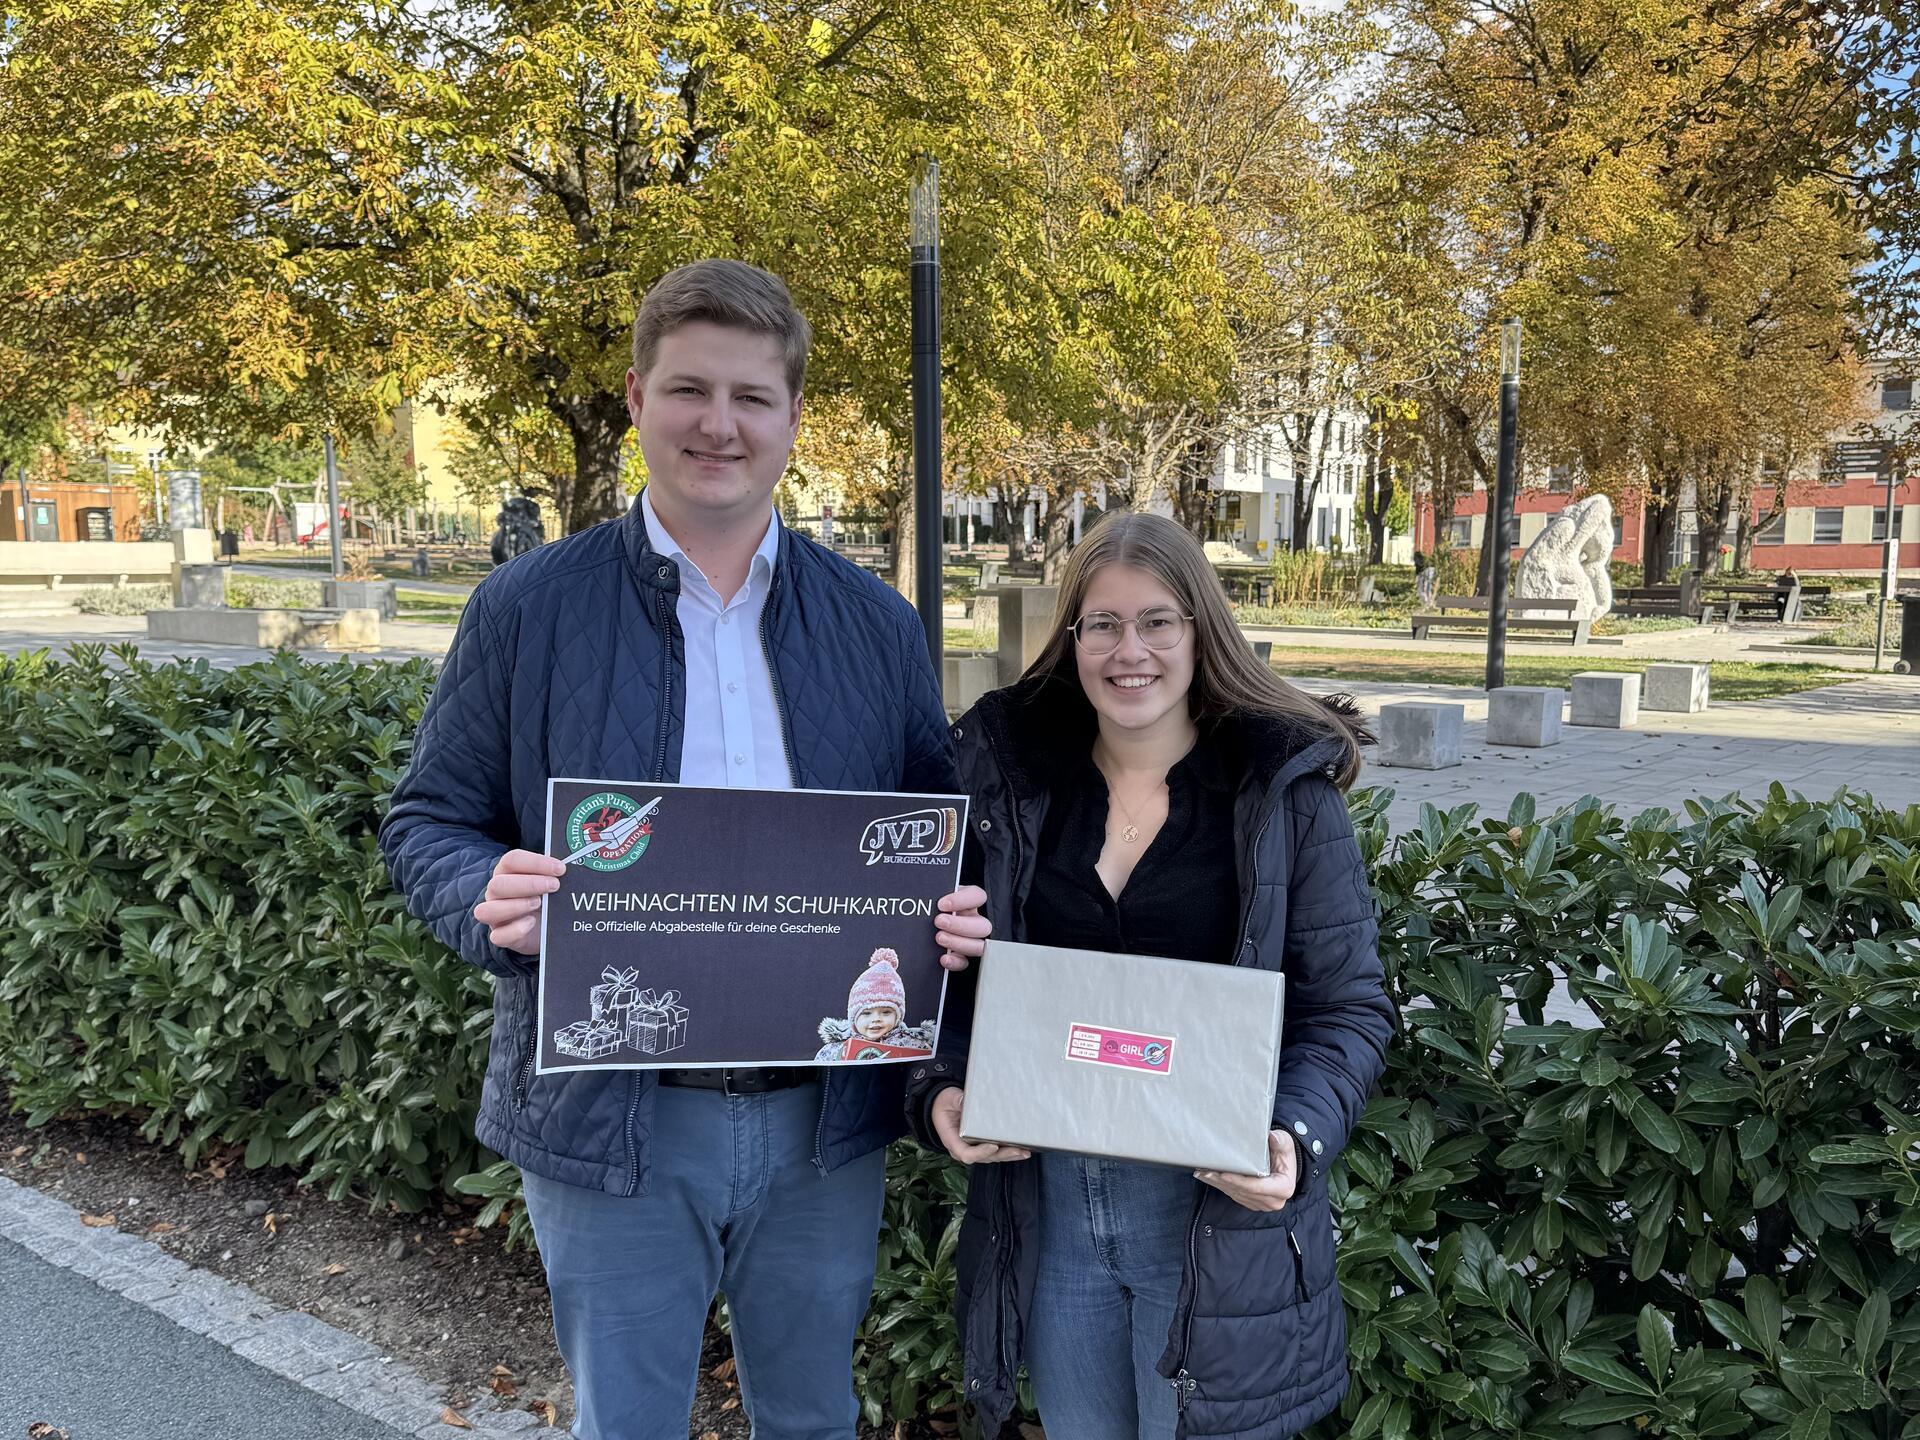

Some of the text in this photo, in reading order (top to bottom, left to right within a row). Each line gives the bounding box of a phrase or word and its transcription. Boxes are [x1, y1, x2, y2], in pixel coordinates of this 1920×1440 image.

[571, 793, 635, 850] Samaritan's Purse
[869, 819, 935, 850] JVP
[592, 842, 646, 871] Christmas Child
[602, 828, 646, 858] OPERATION
[883, 855, 951, 865] BURGENLAND
[571, 892, 933, 917] WEIHNACHTEN IM SCHUHKARTON
[573, 920, 841, 935] Die Offizielle Abgabestelle für deine Geschenke
[1120, 1044, 1144, 1056] GIRL
